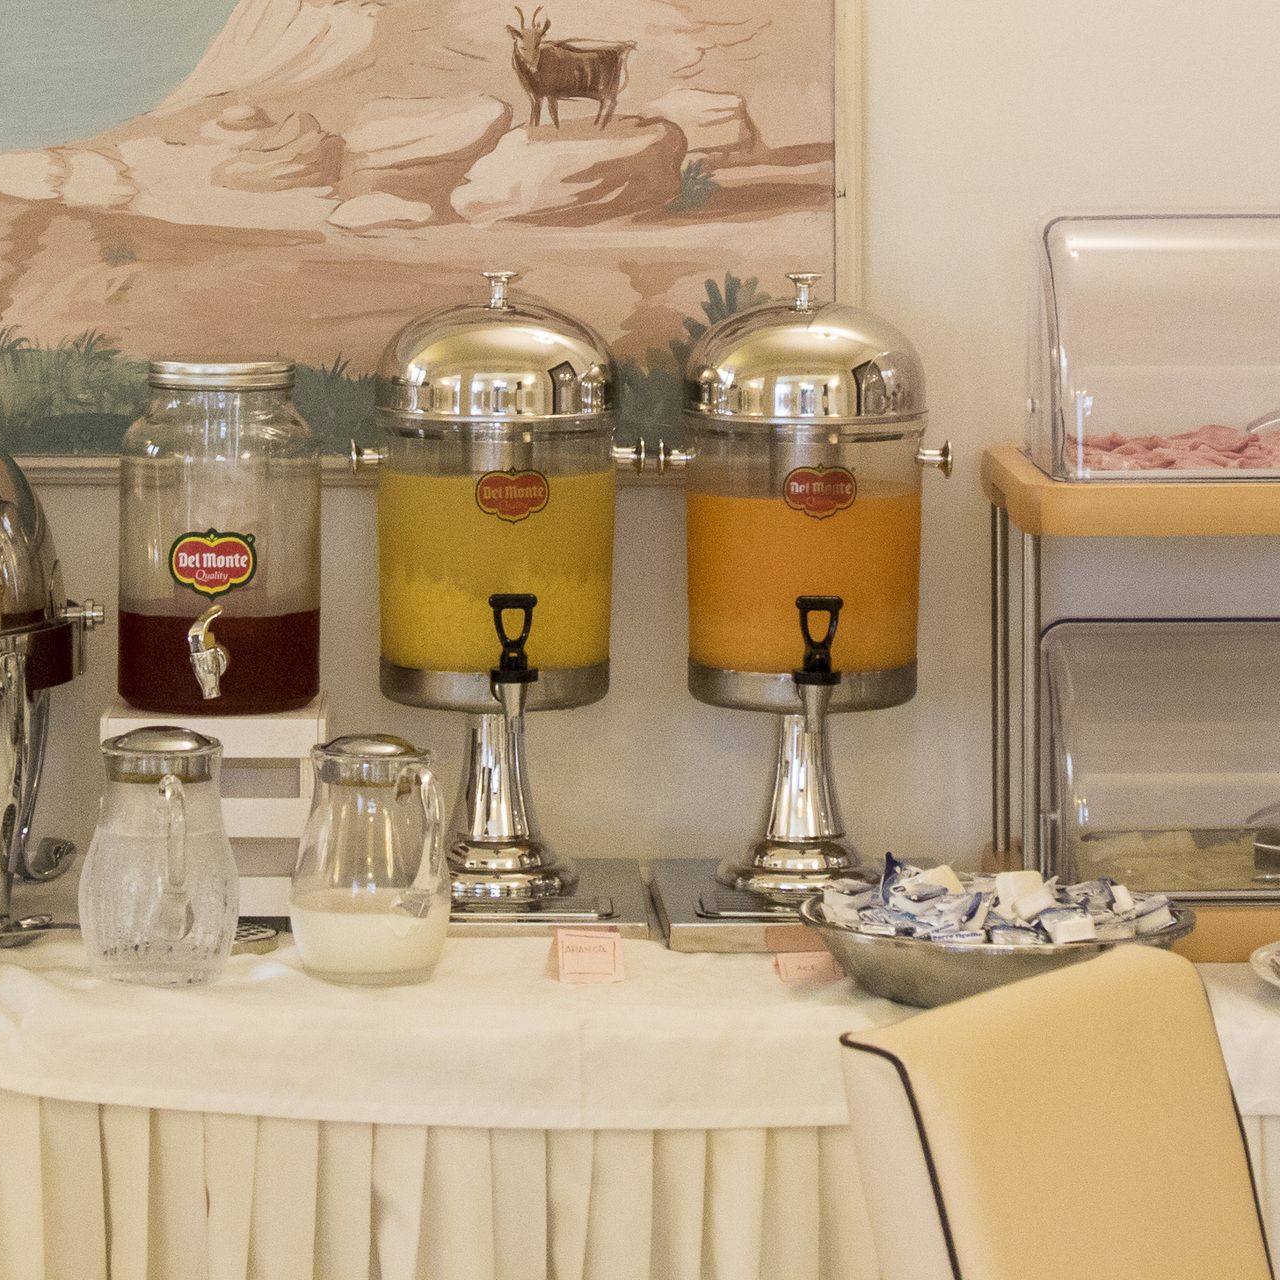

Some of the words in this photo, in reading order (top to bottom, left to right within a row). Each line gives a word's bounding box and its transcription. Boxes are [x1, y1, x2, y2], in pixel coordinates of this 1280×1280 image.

[178, 552, 200, 568] Del
[202, 552, 248, 568] Monte
[195, 569, 229, 583] Quality
